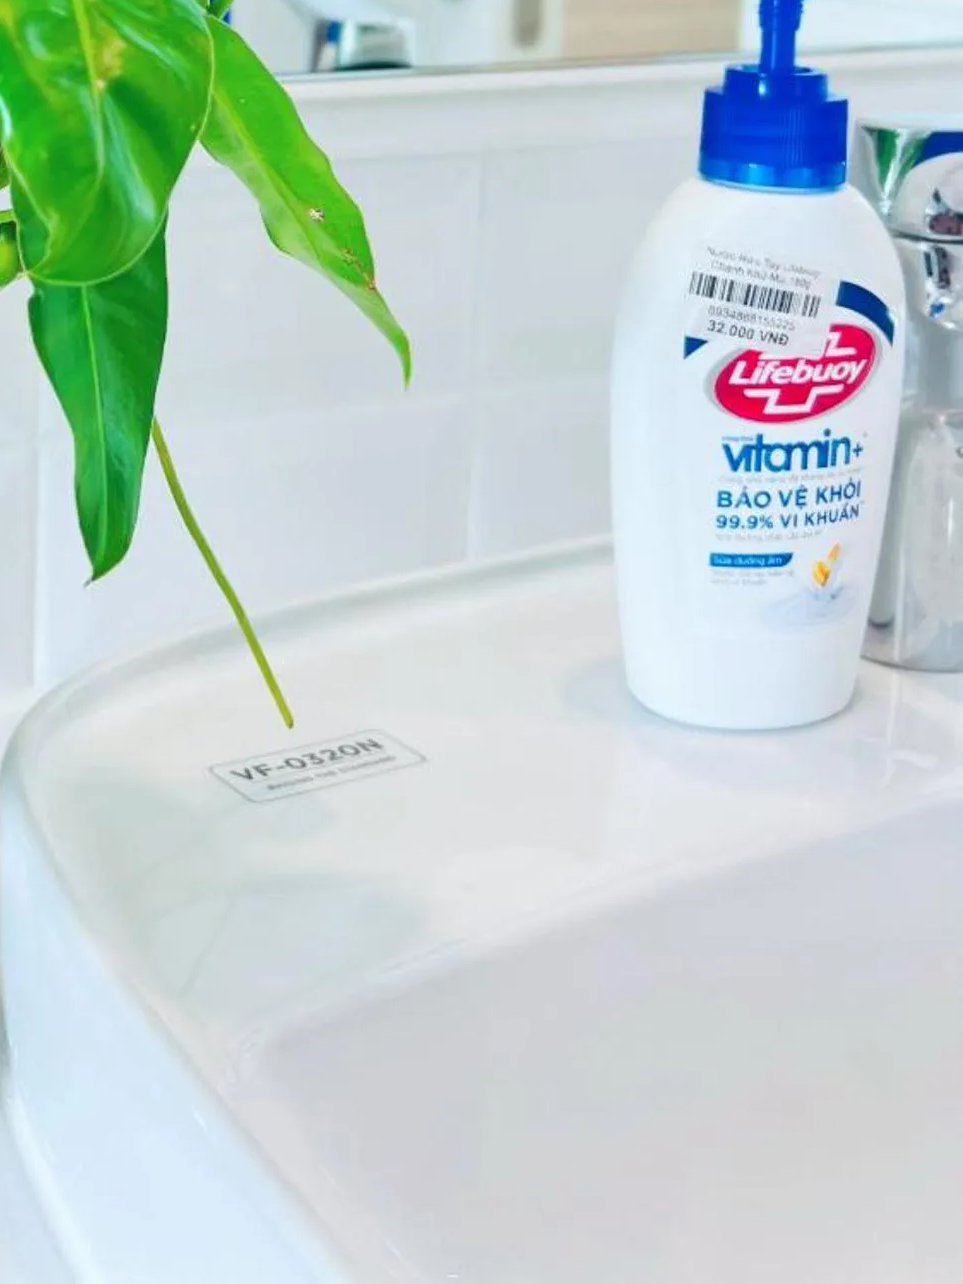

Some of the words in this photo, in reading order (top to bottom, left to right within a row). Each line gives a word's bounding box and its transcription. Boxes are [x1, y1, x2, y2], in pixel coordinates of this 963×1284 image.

[707, 319, 754, 340] 32.000
[759, 330, 789, 346] VNĐ
[729, 357, 867, 385] Lifebuoy
[716, 485, 772, 509] BẢO
[778, 485, 808, 510] VỆ
[816, 477, 862, 505] KHỎI
[716, 515, 773, 530] 99.9%
[781, 514, 798, 529] VI
